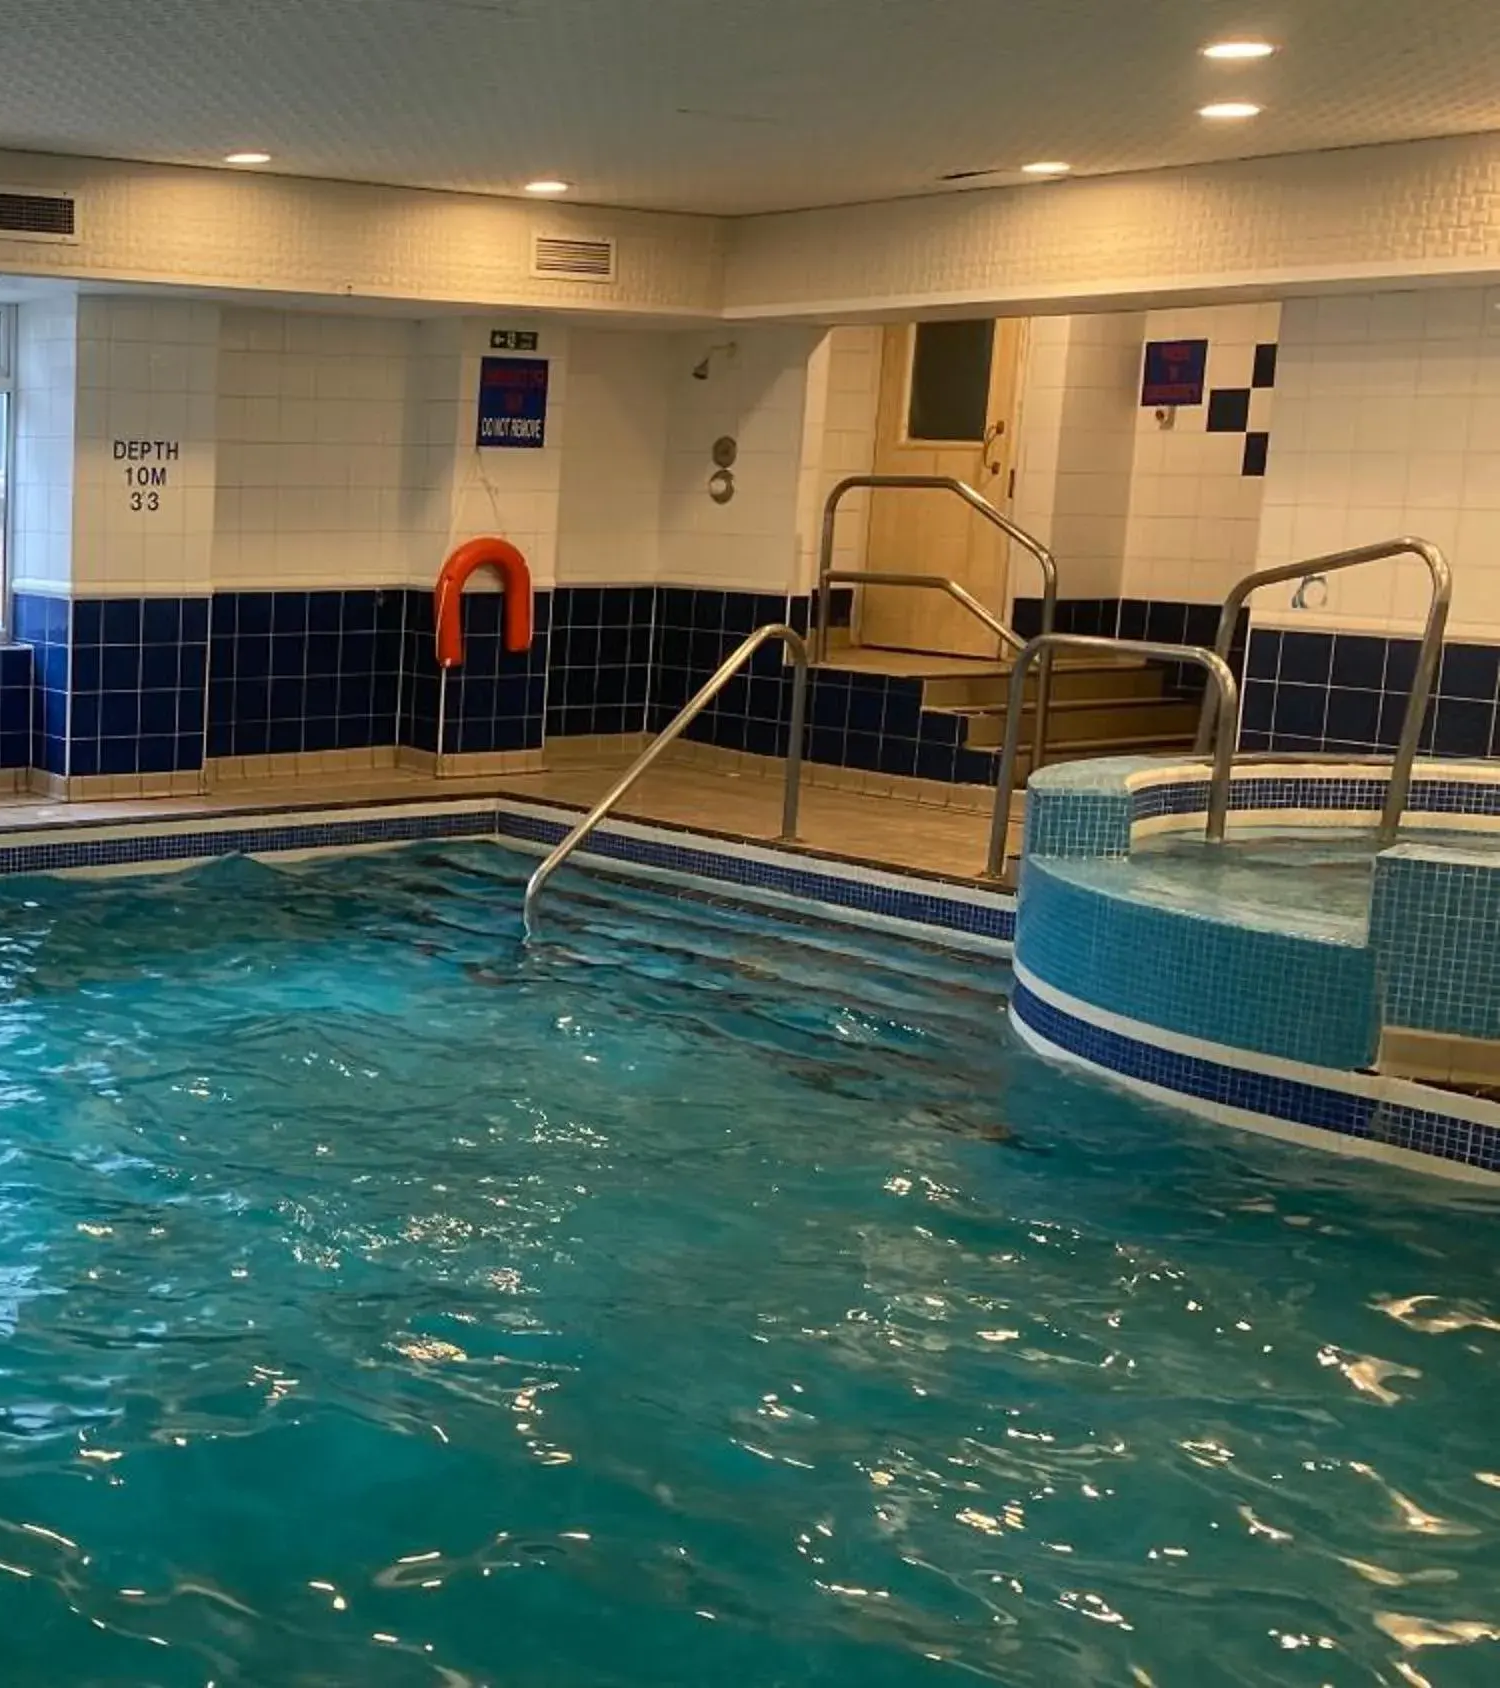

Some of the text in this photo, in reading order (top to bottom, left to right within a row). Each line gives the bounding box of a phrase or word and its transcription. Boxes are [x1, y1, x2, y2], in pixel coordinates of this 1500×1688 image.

[482, 417, 541, 439] DO NOT REMOVE
[113, 440, 179, 460] DEPTH
[125, 467, 166, 486] 10M
